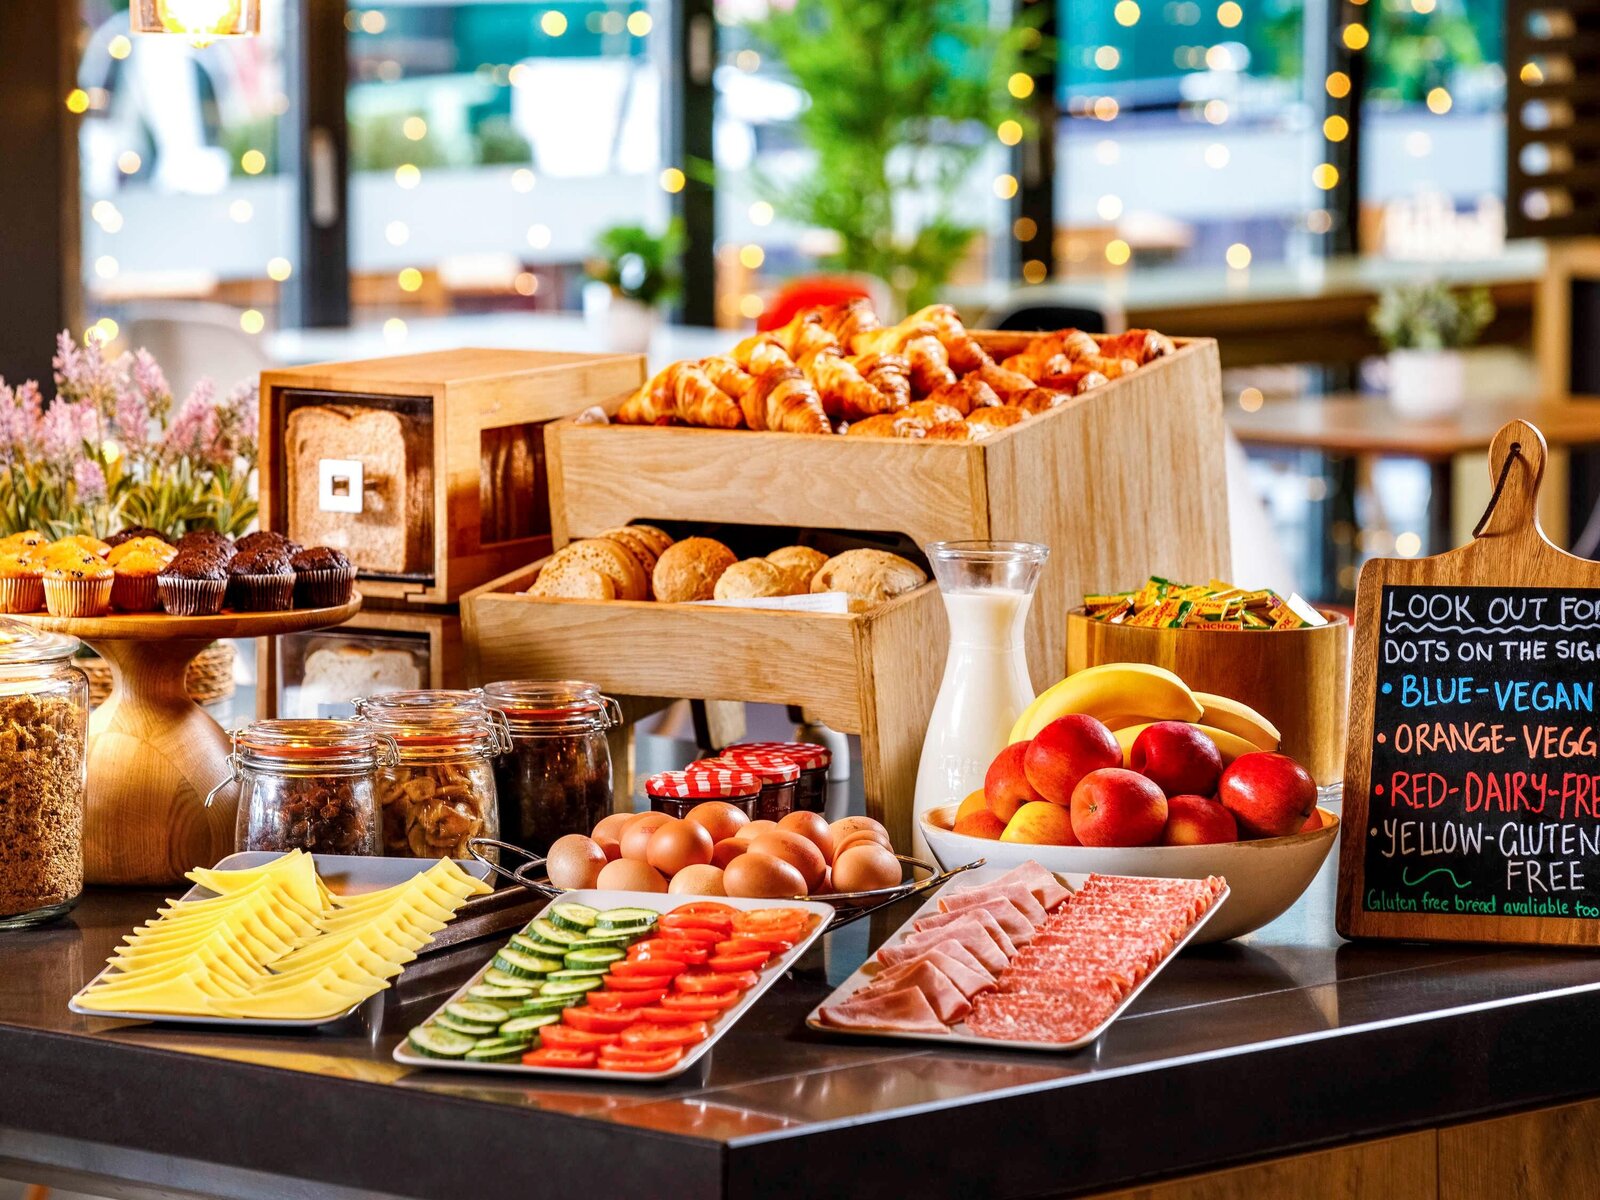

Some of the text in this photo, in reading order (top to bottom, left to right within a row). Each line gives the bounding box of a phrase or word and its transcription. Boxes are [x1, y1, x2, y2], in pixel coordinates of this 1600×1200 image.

[1386, 591, 1476, 623] LOOK
[1488, 596, 1548, 622] OUT
[1385, 639, 1600, 664] DOTS ON THE SIG
[1402, 674, 1593, 712] BLUE-VEGAN
[1382, 821, 1600, 858] YELLOW-GLUTEN
[1508, 860, 1585, 893] FREE
[1367, 888, 1599, 918] Gluten free bread avaliable too
